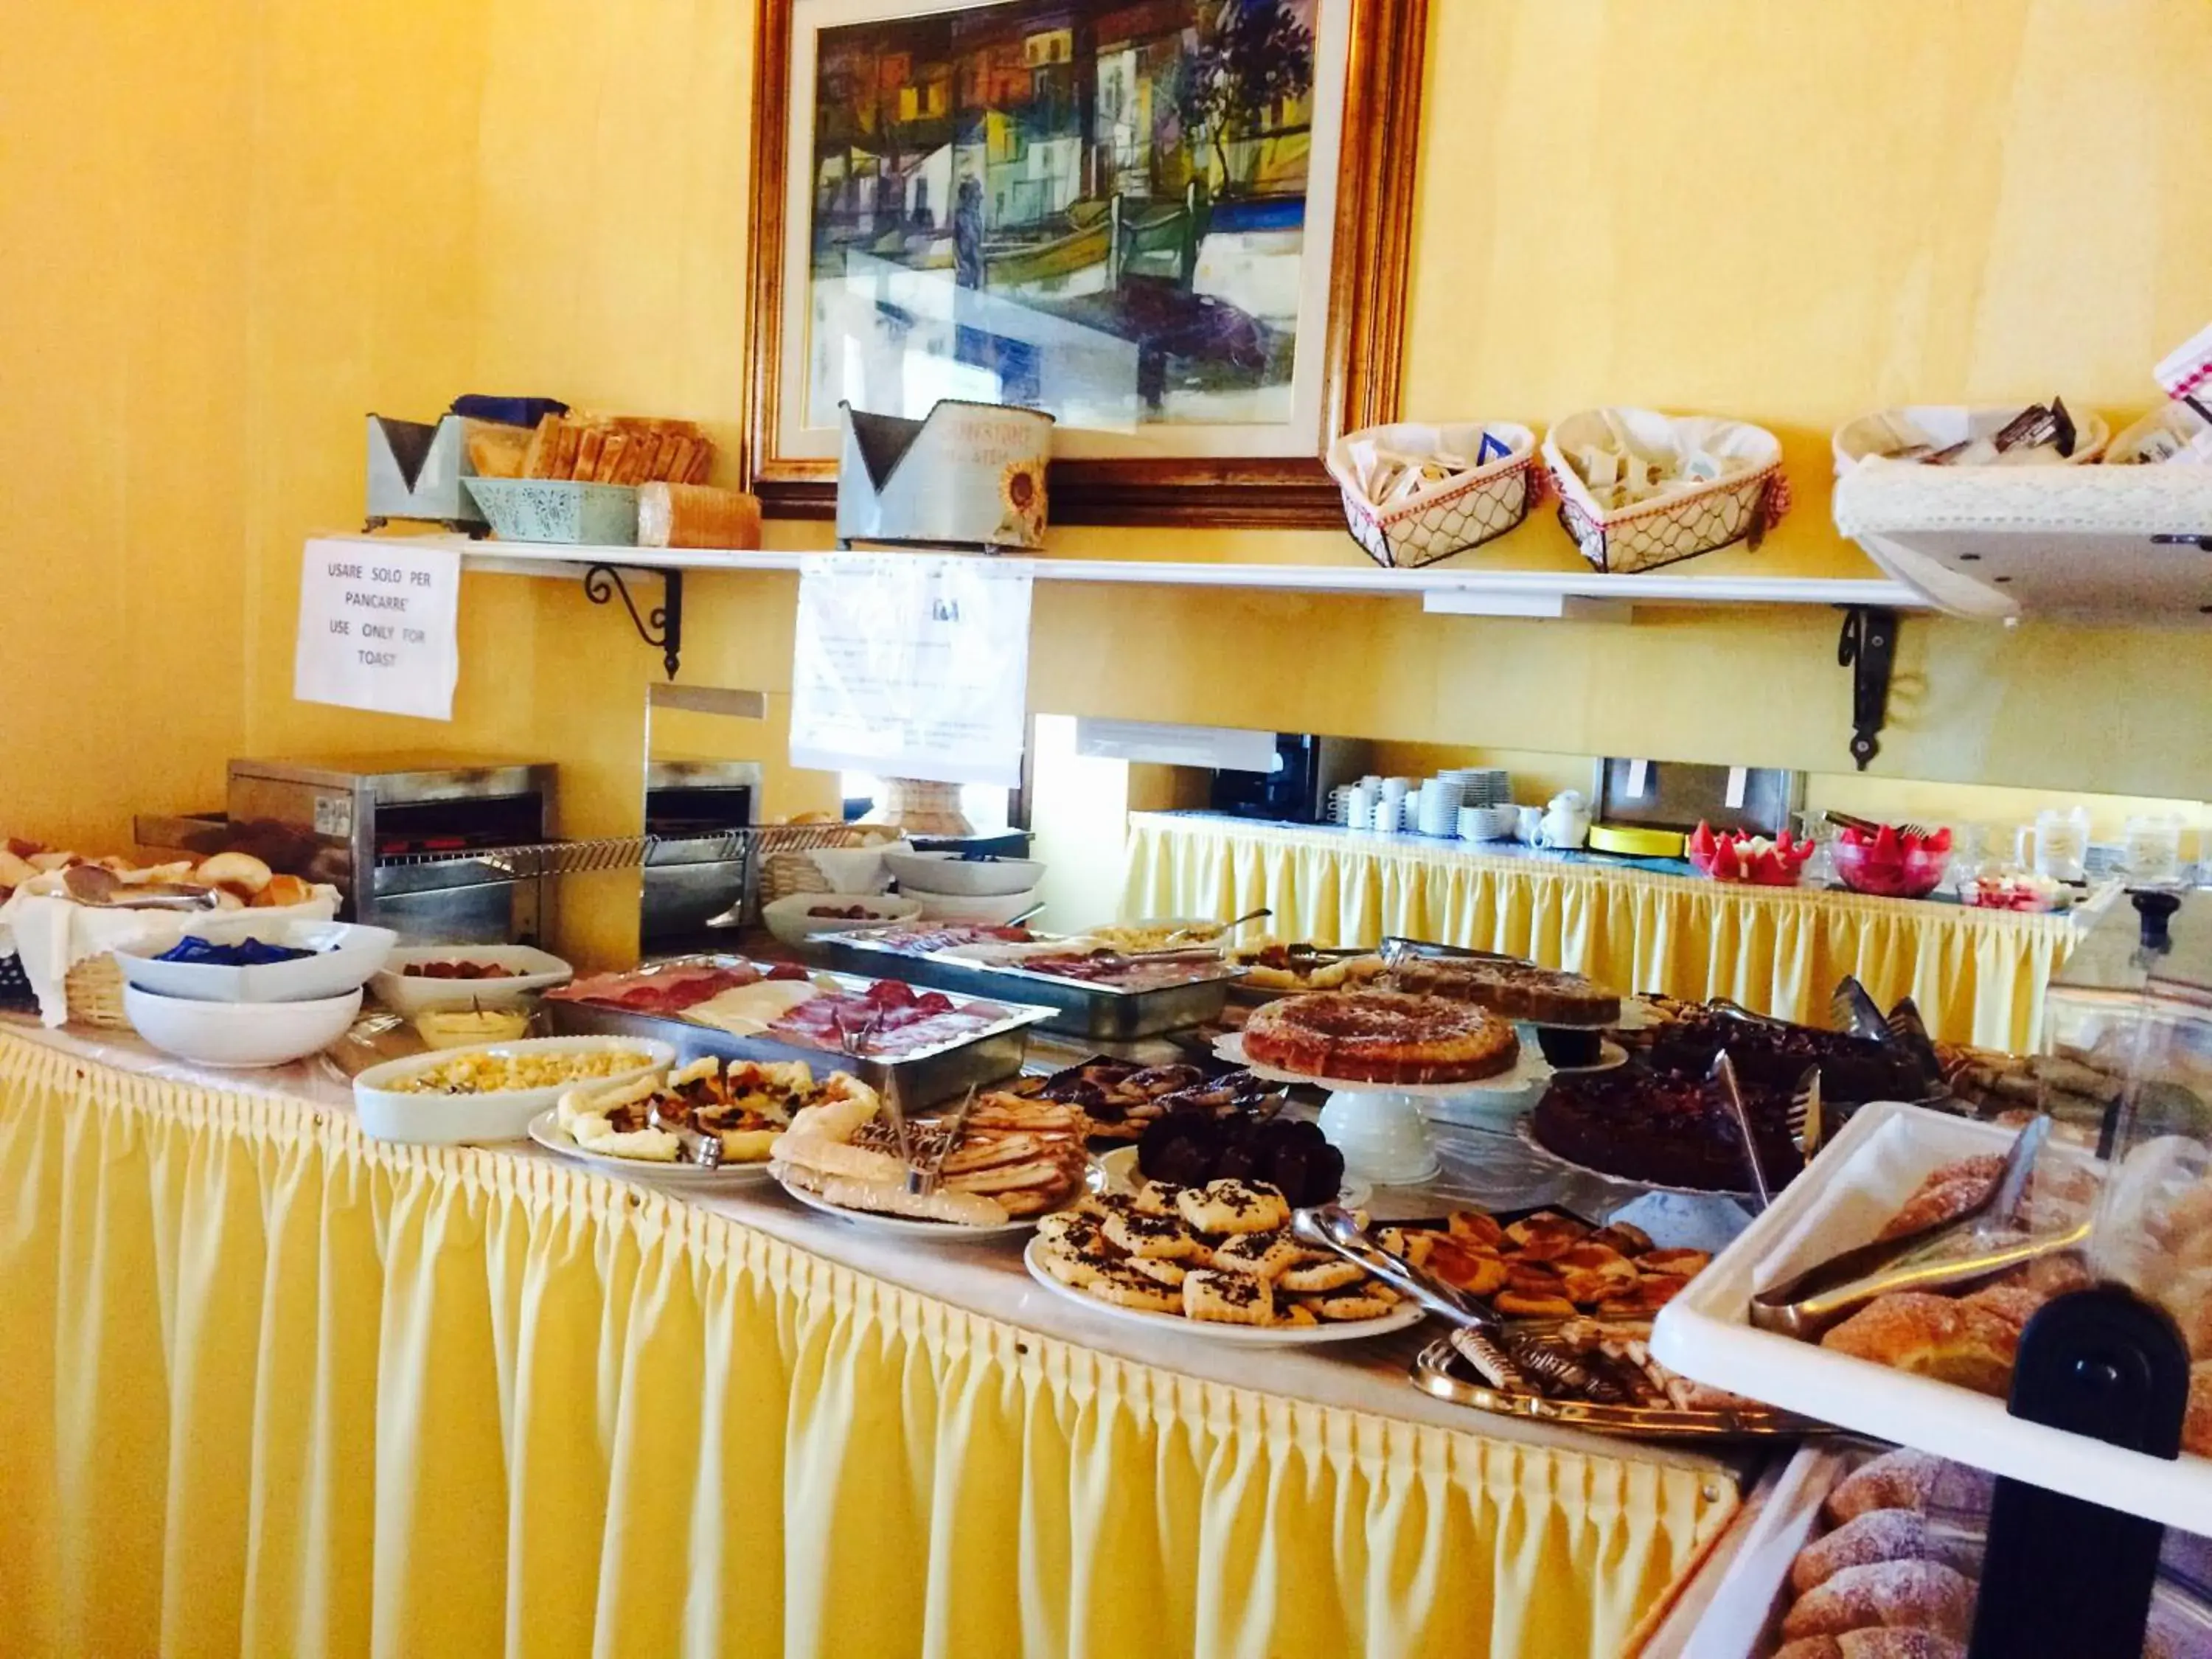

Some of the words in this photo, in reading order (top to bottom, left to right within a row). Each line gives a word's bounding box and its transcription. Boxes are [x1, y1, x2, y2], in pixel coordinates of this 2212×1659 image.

[328, 563, 362, 579] USARE
[372, 567, 402, 583] SOLO
[410, 572, 431, 586] PER
[330, 619, 350, 635] USE
[361, 623, 394, 640] ONLY
[403, 628, 425, 644] FOR
[358, 650, 396, 666] TOAST
